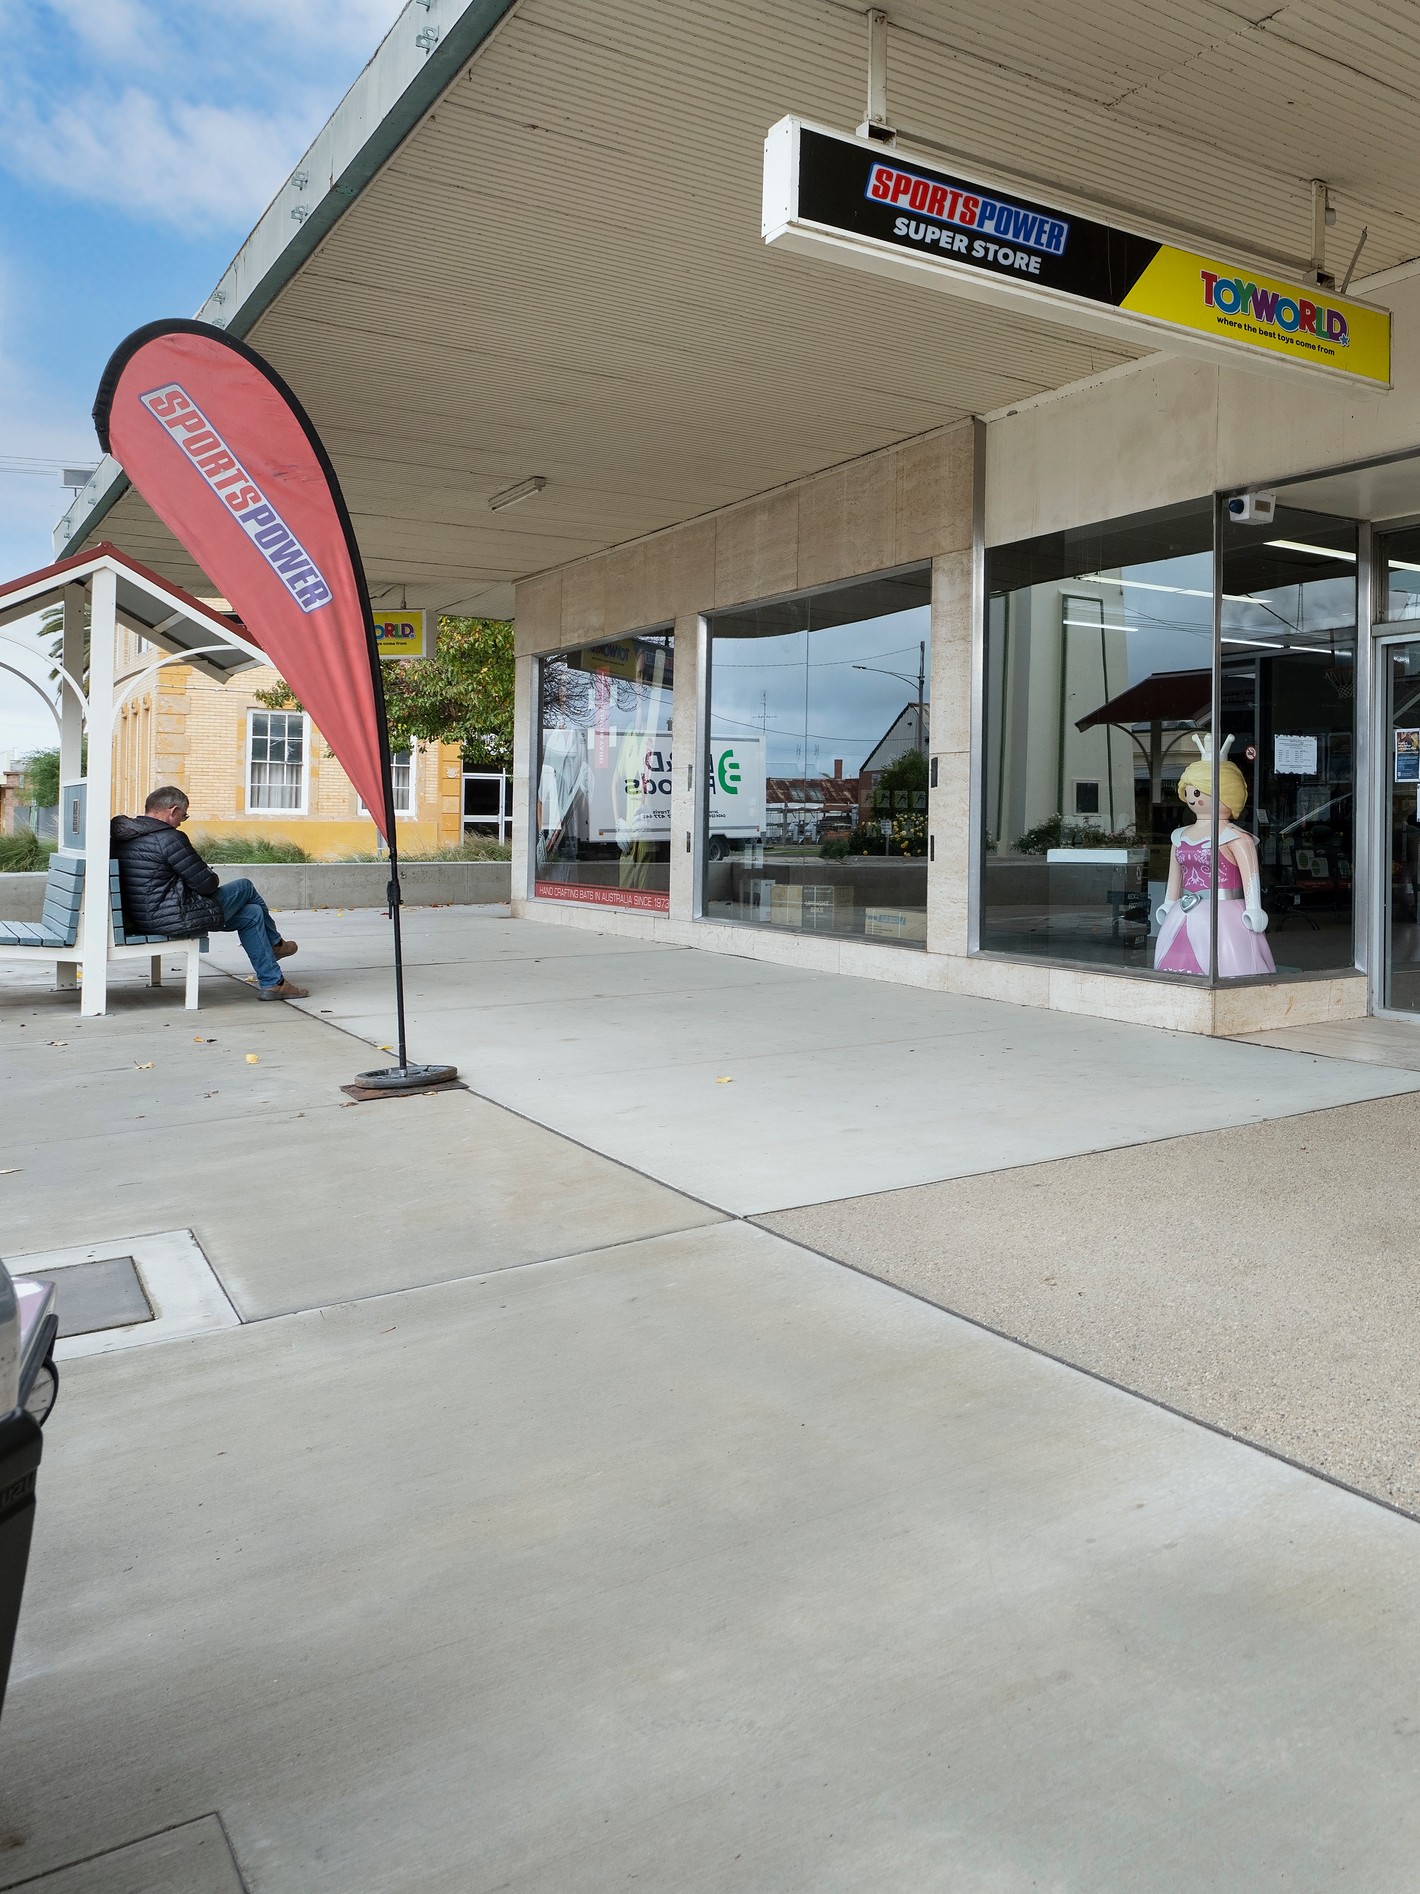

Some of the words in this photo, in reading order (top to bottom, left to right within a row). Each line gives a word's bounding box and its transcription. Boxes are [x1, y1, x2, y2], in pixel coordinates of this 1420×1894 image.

[871, 168, 1065, 251] SPORTSPOWER
[893, 217, 969, 254] SUPER
[971, 239, 1042, 275] STORE
[1200, 270, 1348, 343] TOYWORLD
[1217, 316, 1242, 329] where
[1243, 323, 1257, 333] the
[1258, 325, 1276, 339] best
[1277, 333, 1294, 345] toys
[1295, 339, 1316, 351] come
[1317, 344, 1335, 356] from
[149, 390, 329, 608] SPORTSPOWER
[374, 622, 415, 640] ORLD
[540, 886, 553, 896] HAND
[554, 887, 579, 899] CRAFTING
[580, 889, 594, 900] BATS
[594, 891, 600, 901] IN
[601, 892, 633, 904] AUSTRALIA
[634, 895, 652, 907] SINCE
[654, 898, 669, 909] 1973
